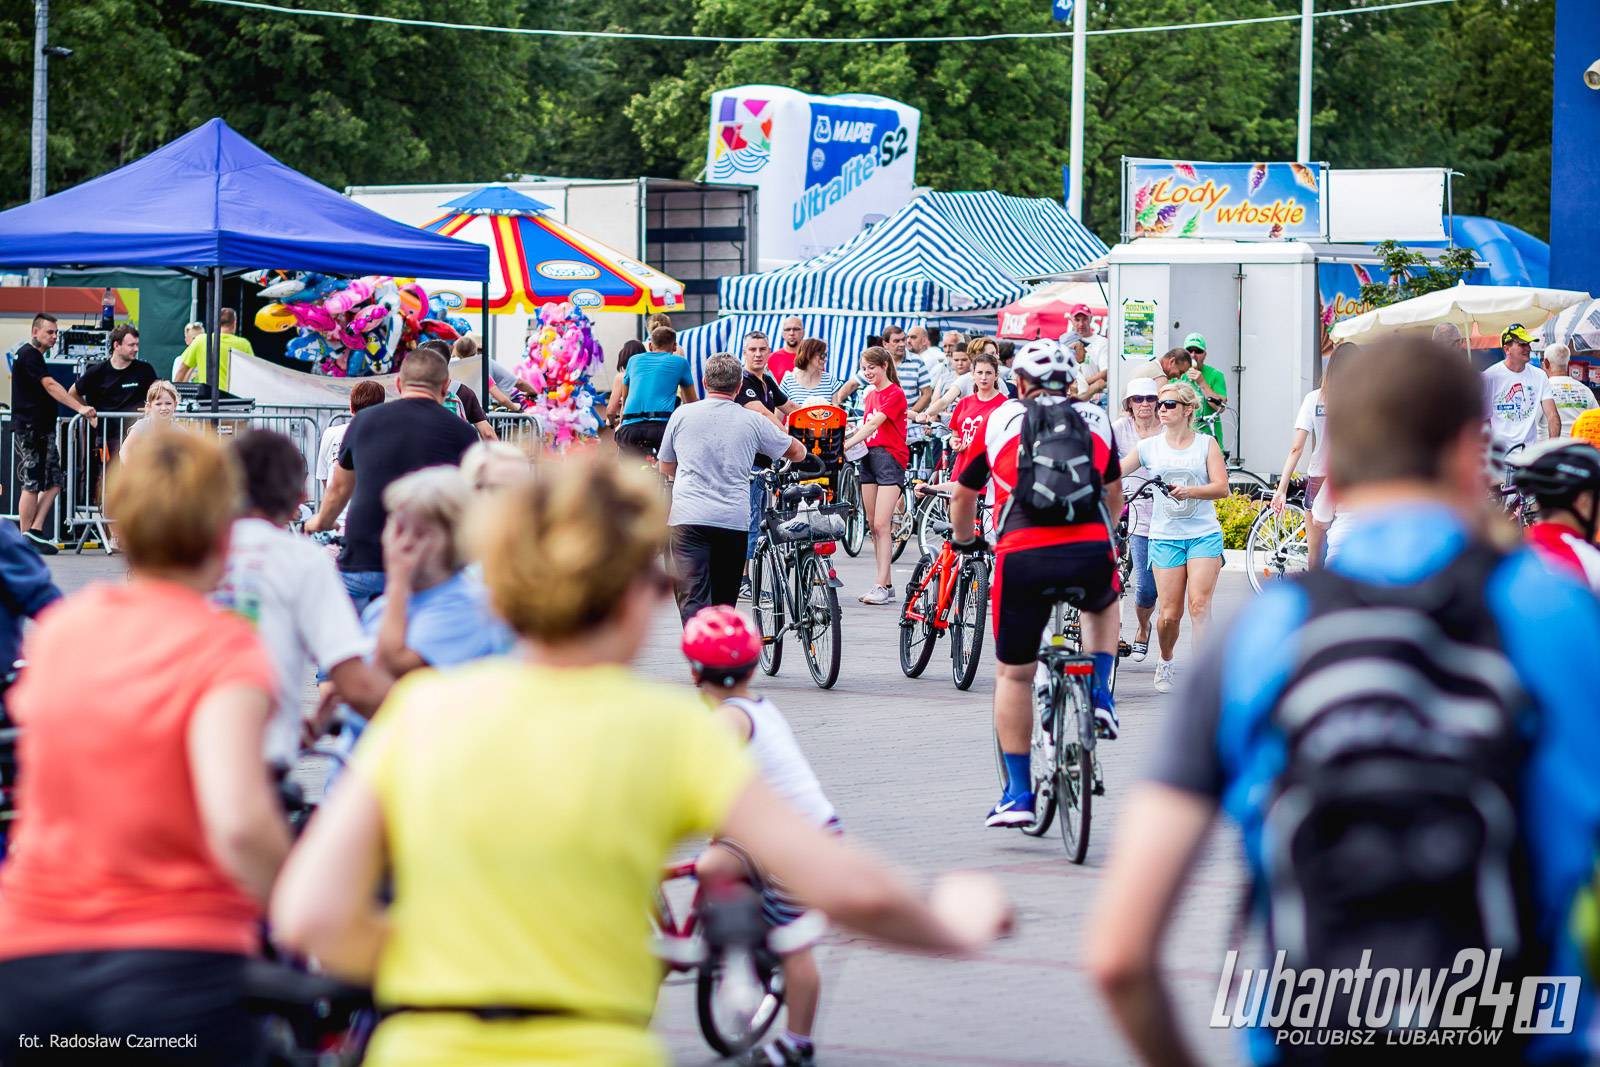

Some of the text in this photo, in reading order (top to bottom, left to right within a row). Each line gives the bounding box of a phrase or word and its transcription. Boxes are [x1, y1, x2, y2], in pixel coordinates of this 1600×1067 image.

[793, 126, 908, 231] Ultralite S2
[1153, 180, 1229, 211] Lody
[1216, 199, 1304, 224] włoskie
